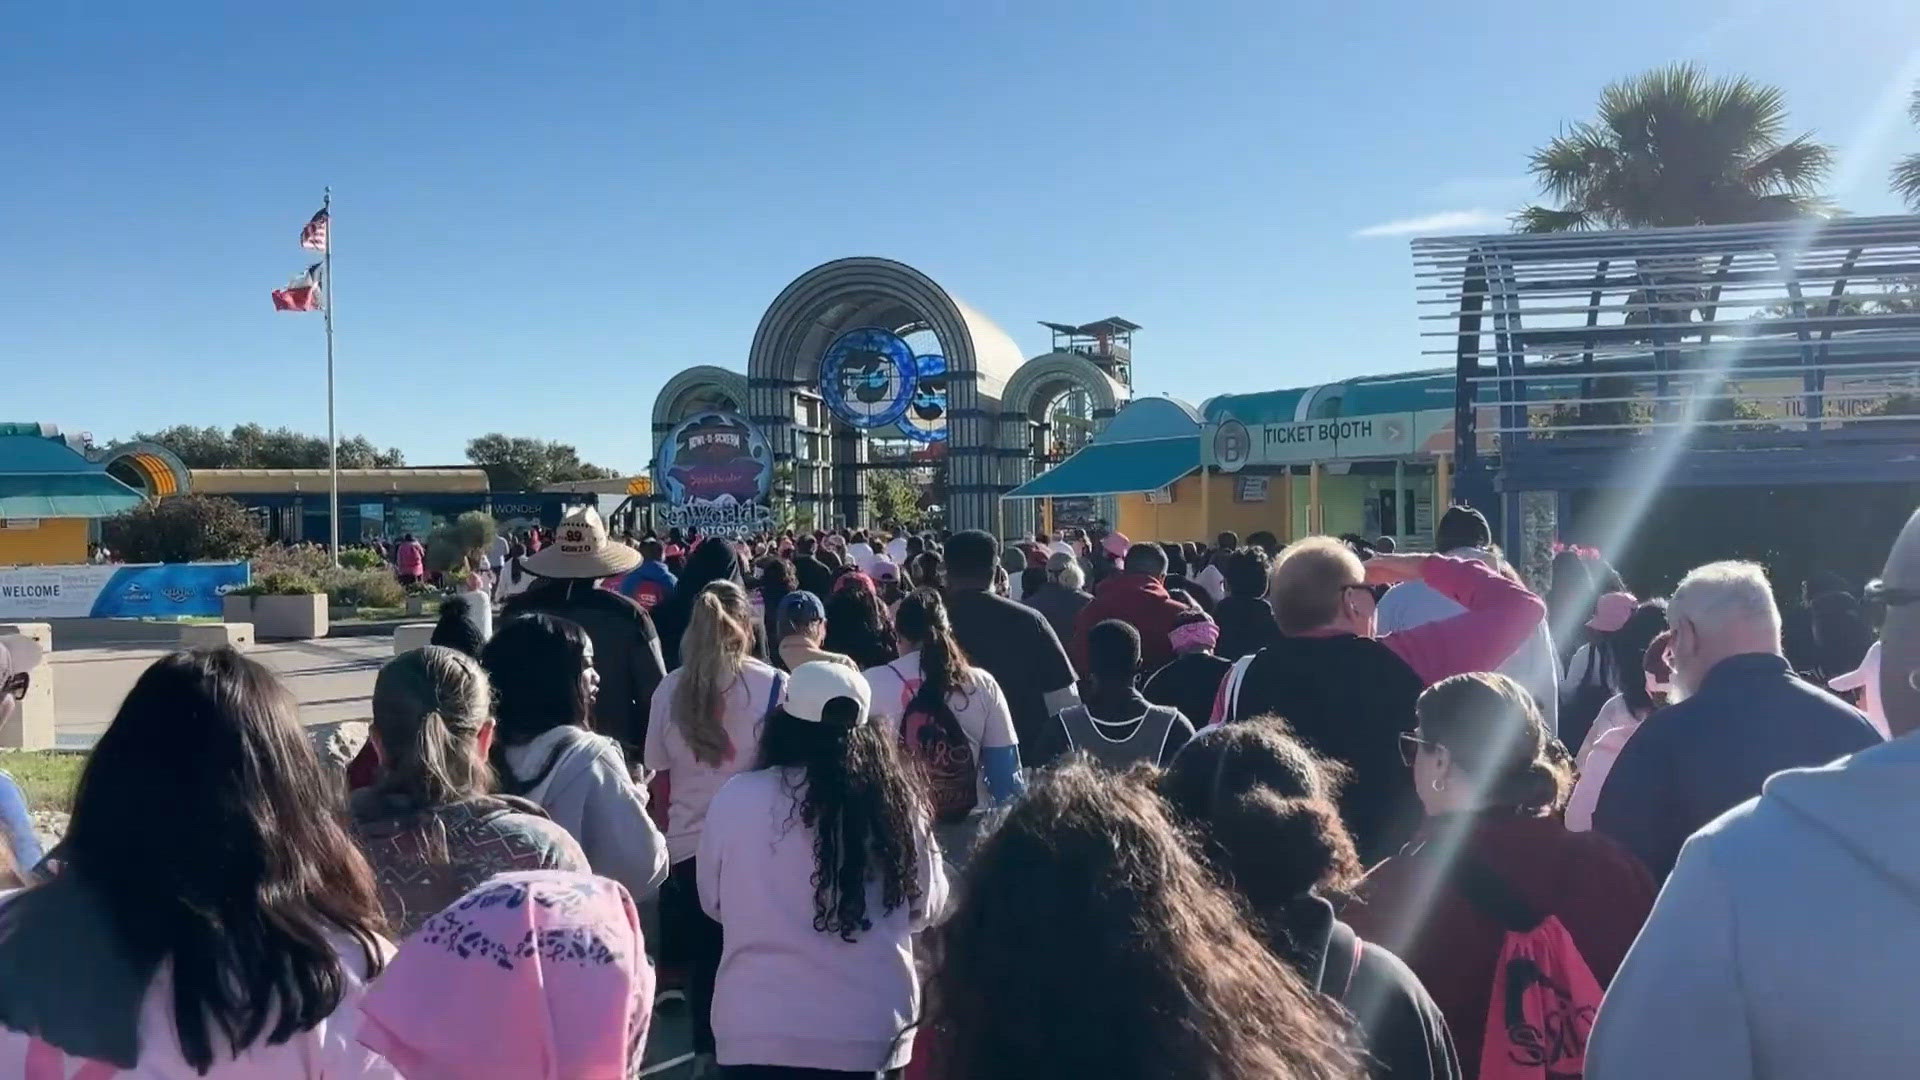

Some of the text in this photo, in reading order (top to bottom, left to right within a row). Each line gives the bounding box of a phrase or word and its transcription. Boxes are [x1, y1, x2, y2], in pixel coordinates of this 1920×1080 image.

[1266, 421, 1372, 444] TICKET BOOTH
[1225, 436, 1240, 463] B
[494, 504, 542, 513] WONDER
[698, 524, 750, 537] NTONIO
[2, 585, 60, 597] WELCOME
